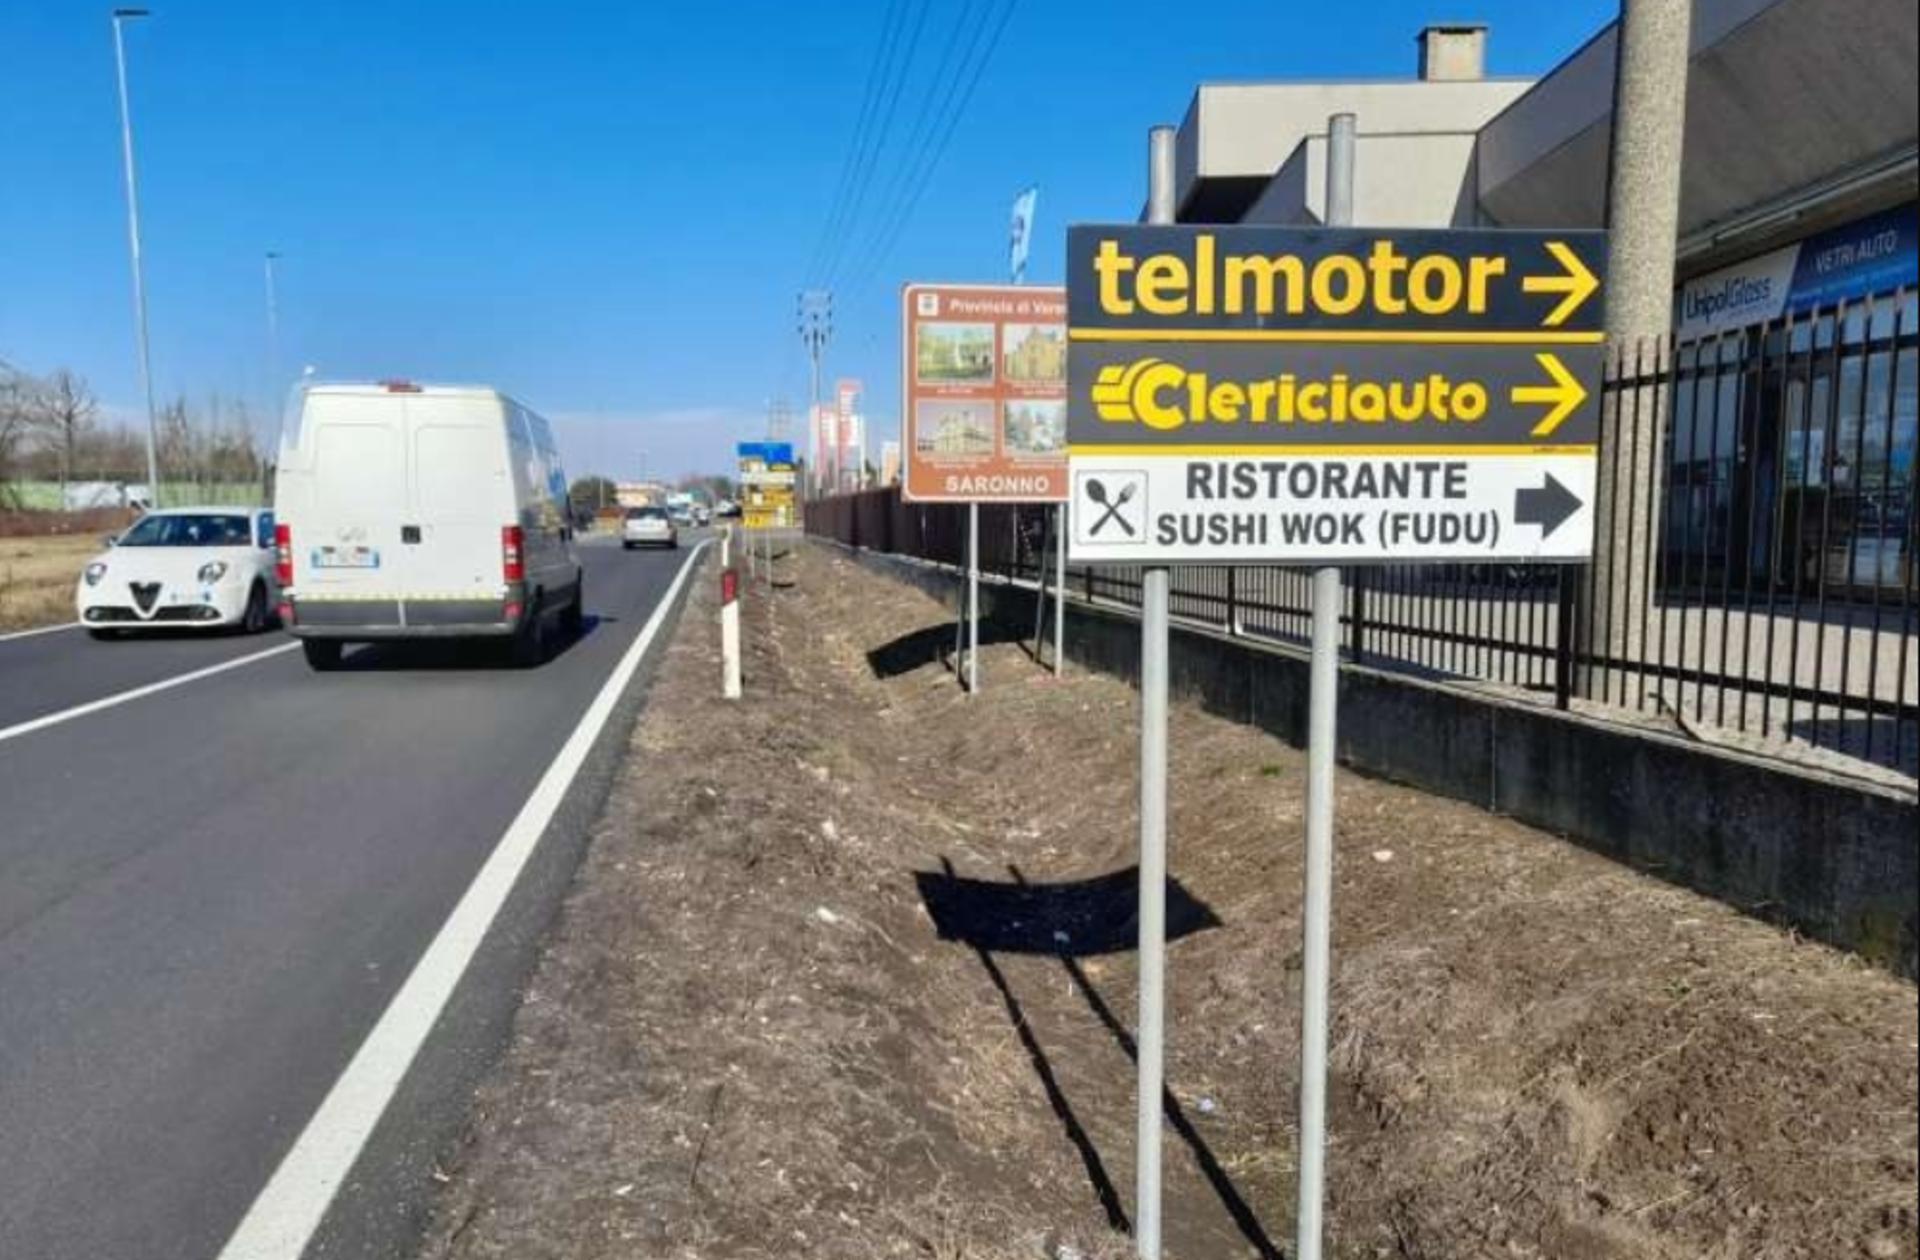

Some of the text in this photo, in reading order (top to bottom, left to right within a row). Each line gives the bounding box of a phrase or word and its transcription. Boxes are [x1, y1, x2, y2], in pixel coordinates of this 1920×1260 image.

[1857, 228, 1897, 260] AUTO
[1094, 235, 1506, 316] telmotor
[1133, 362, 1487, 430] Clericiauto
[945, 476, 1050, 494] SARONNO
[1186, 461, 1469, 499] RISTORANTE
[1156, 509, 1501, 548] SUSHI WOK (FUDU)
